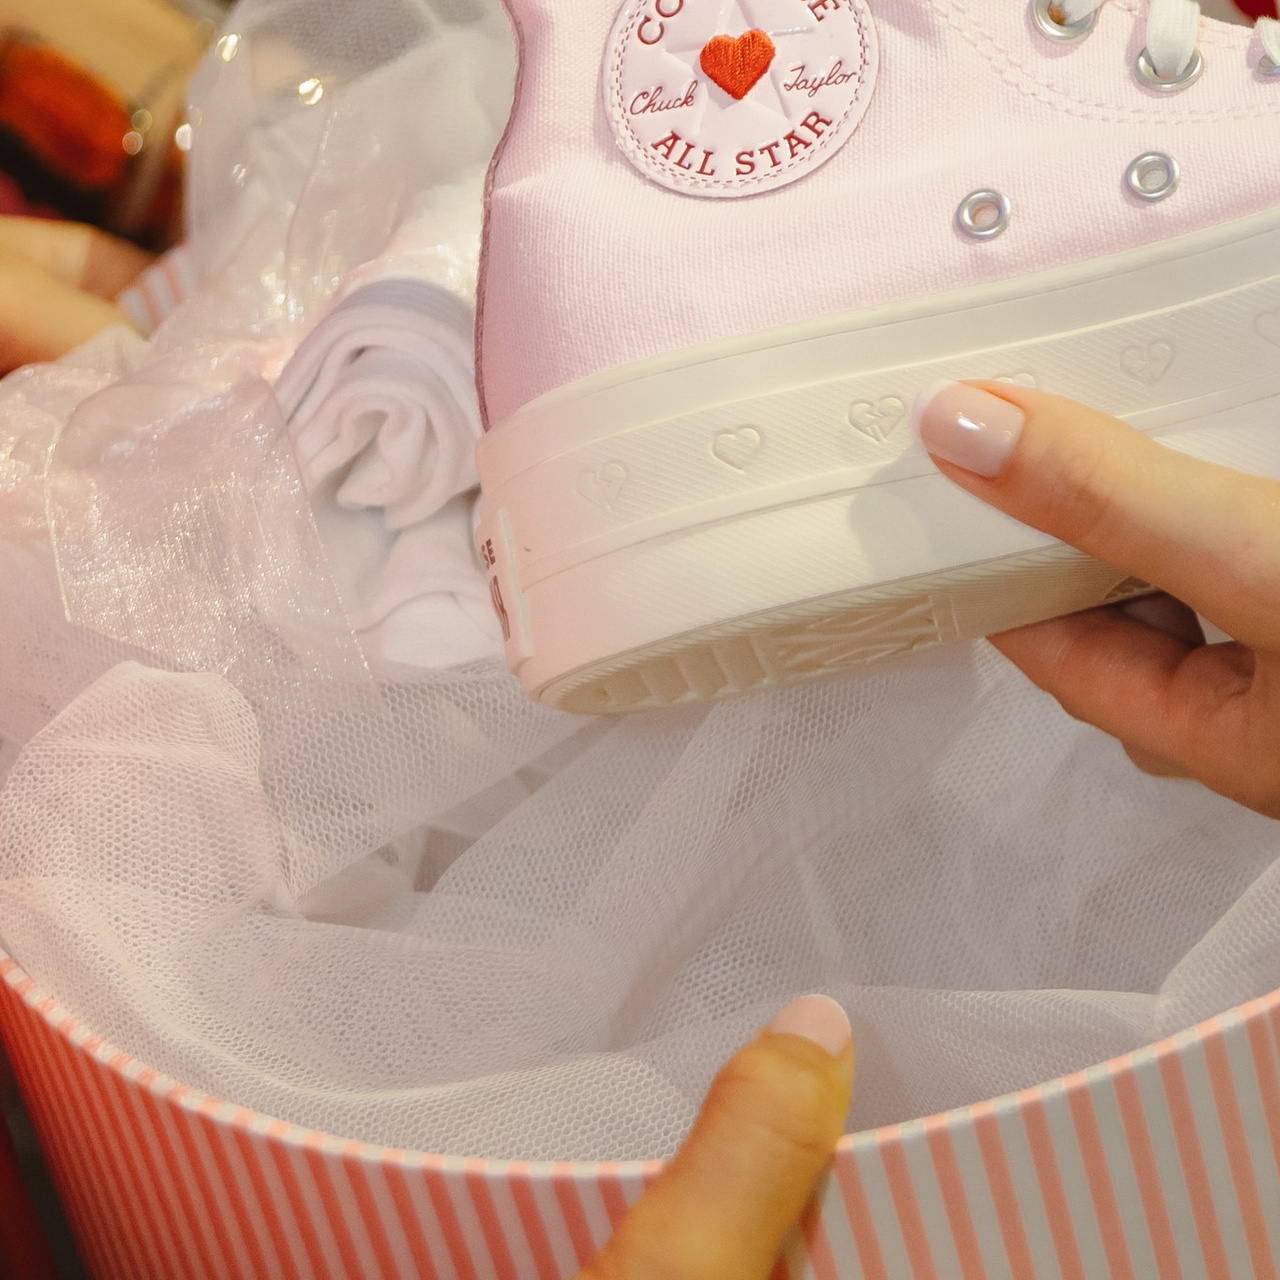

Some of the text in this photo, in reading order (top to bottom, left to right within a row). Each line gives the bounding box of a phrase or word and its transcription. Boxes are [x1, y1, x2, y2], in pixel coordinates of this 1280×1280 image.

[629, 60, 858, 115] Chuck Taylor
[651, 111, 833, 176] ALL STAR
